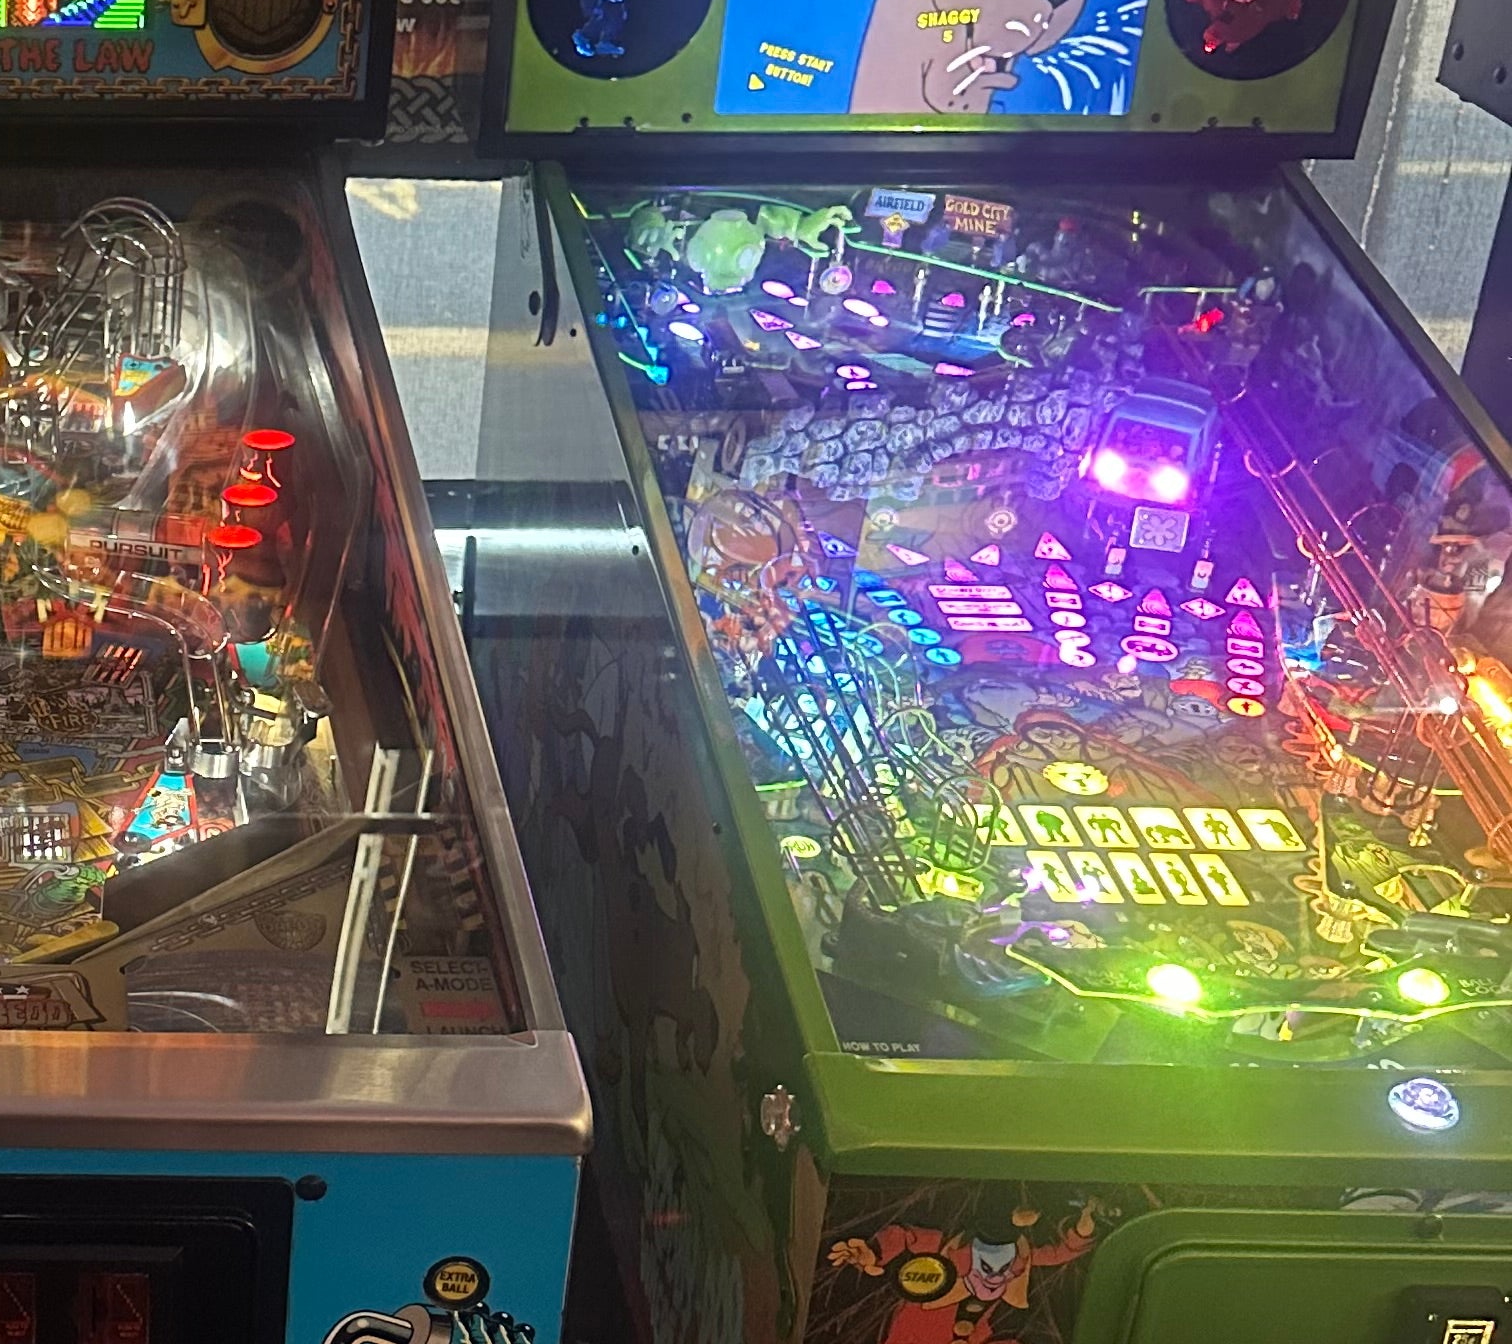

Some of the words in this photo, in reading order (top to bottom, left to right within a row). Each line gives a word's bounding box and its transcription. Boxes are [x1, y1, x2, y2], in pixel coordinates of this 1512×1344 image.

[916, 7, 981, 29] SHAGGY
[72, 37, 156, 74] LAW
[759, 41, 798, 63] PRESS
[799, 53, 835, 74] START
[764, 64, 814, 87] BUTTON!
[874, 195, 926, 213] AIRFIELD
[944, 199, 980, 217] GOLD
[981, 205, 1010, 222] CITY
[954, 216, 998, 235] MINE
[89, 539, 184, 560] PURSUIT
[415, 977, 495, 992] A-MODE
[842, 1040, 873, 1054] HOW
[874, 1041, 890, 1054] TO
[892, 1041, 922, 1055] PLAY
[438, 1270, 476, 1285] EXTRA
[901, 1269, 943, 1286] START
[440, 1281, 470, 1296] BALL
